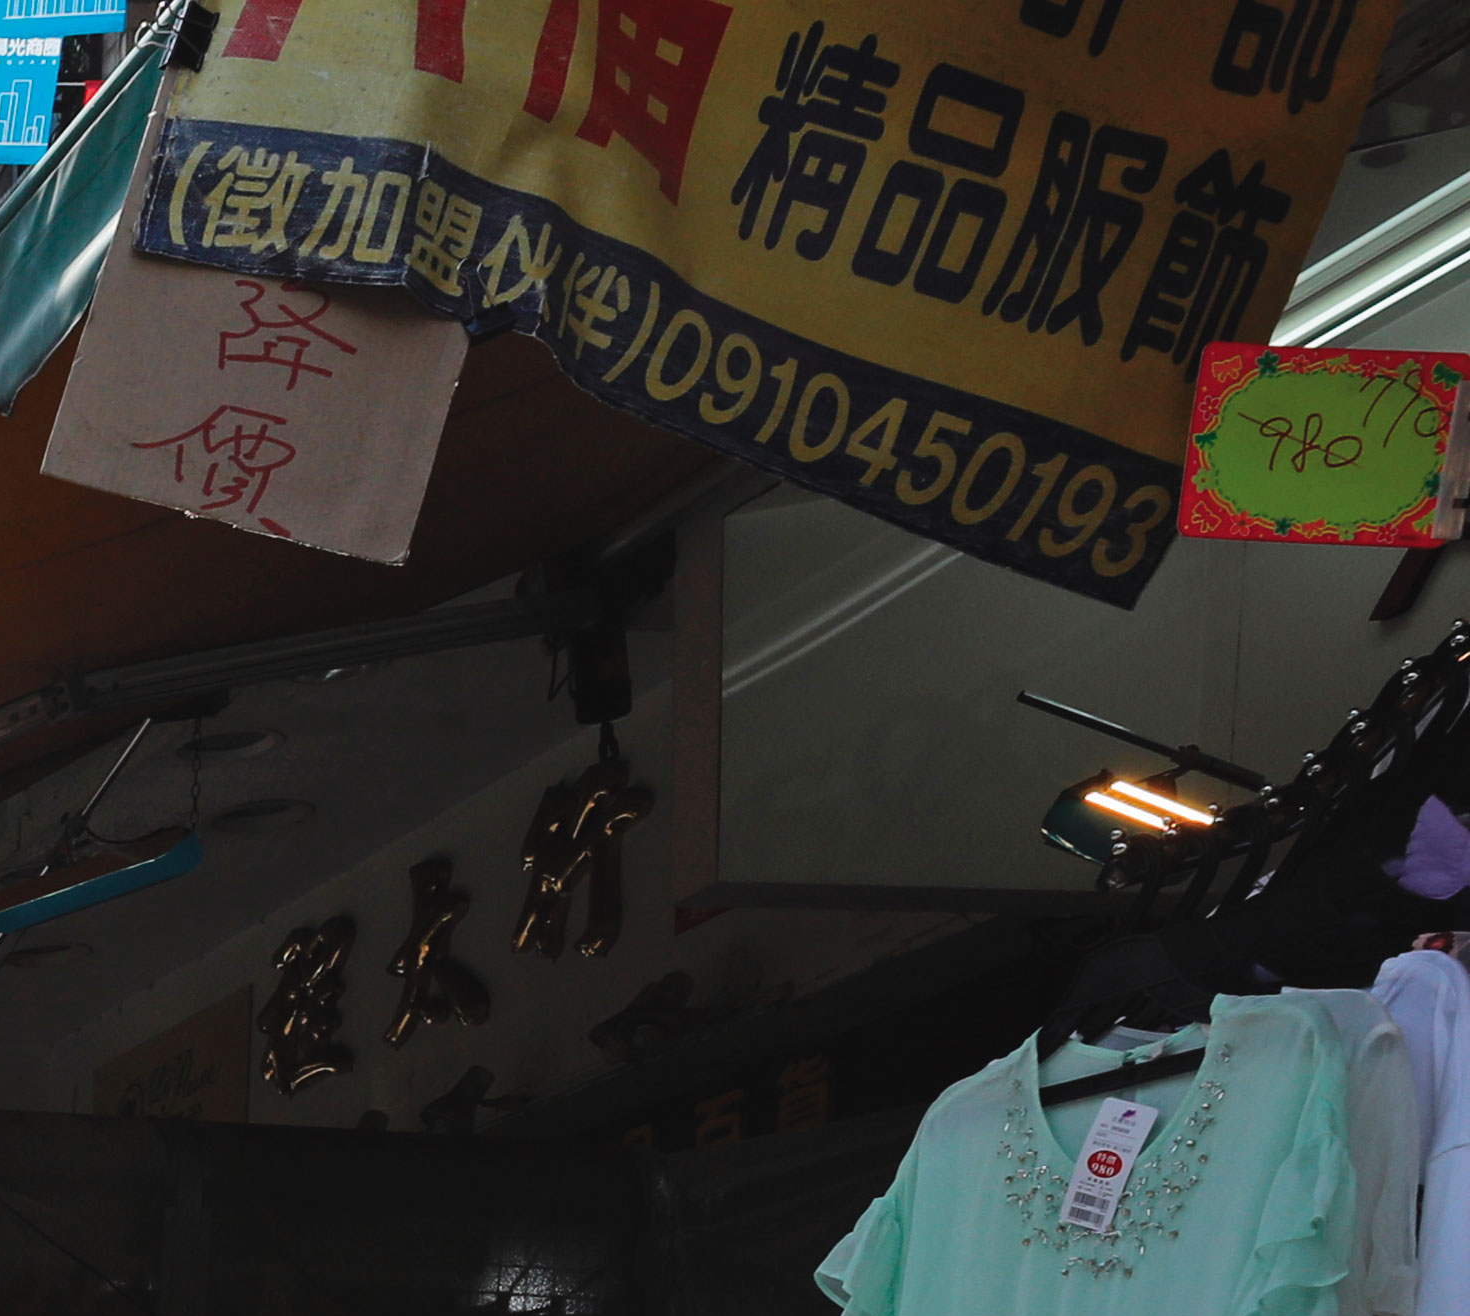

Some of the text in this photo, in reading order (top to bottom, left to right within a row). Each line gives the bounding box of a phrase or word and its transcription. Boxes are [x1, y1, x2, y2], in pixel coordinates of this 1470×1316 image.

[730, 20, 1294, 382] 精品服飾
[1090, 1161, 1115, 1177] 980
